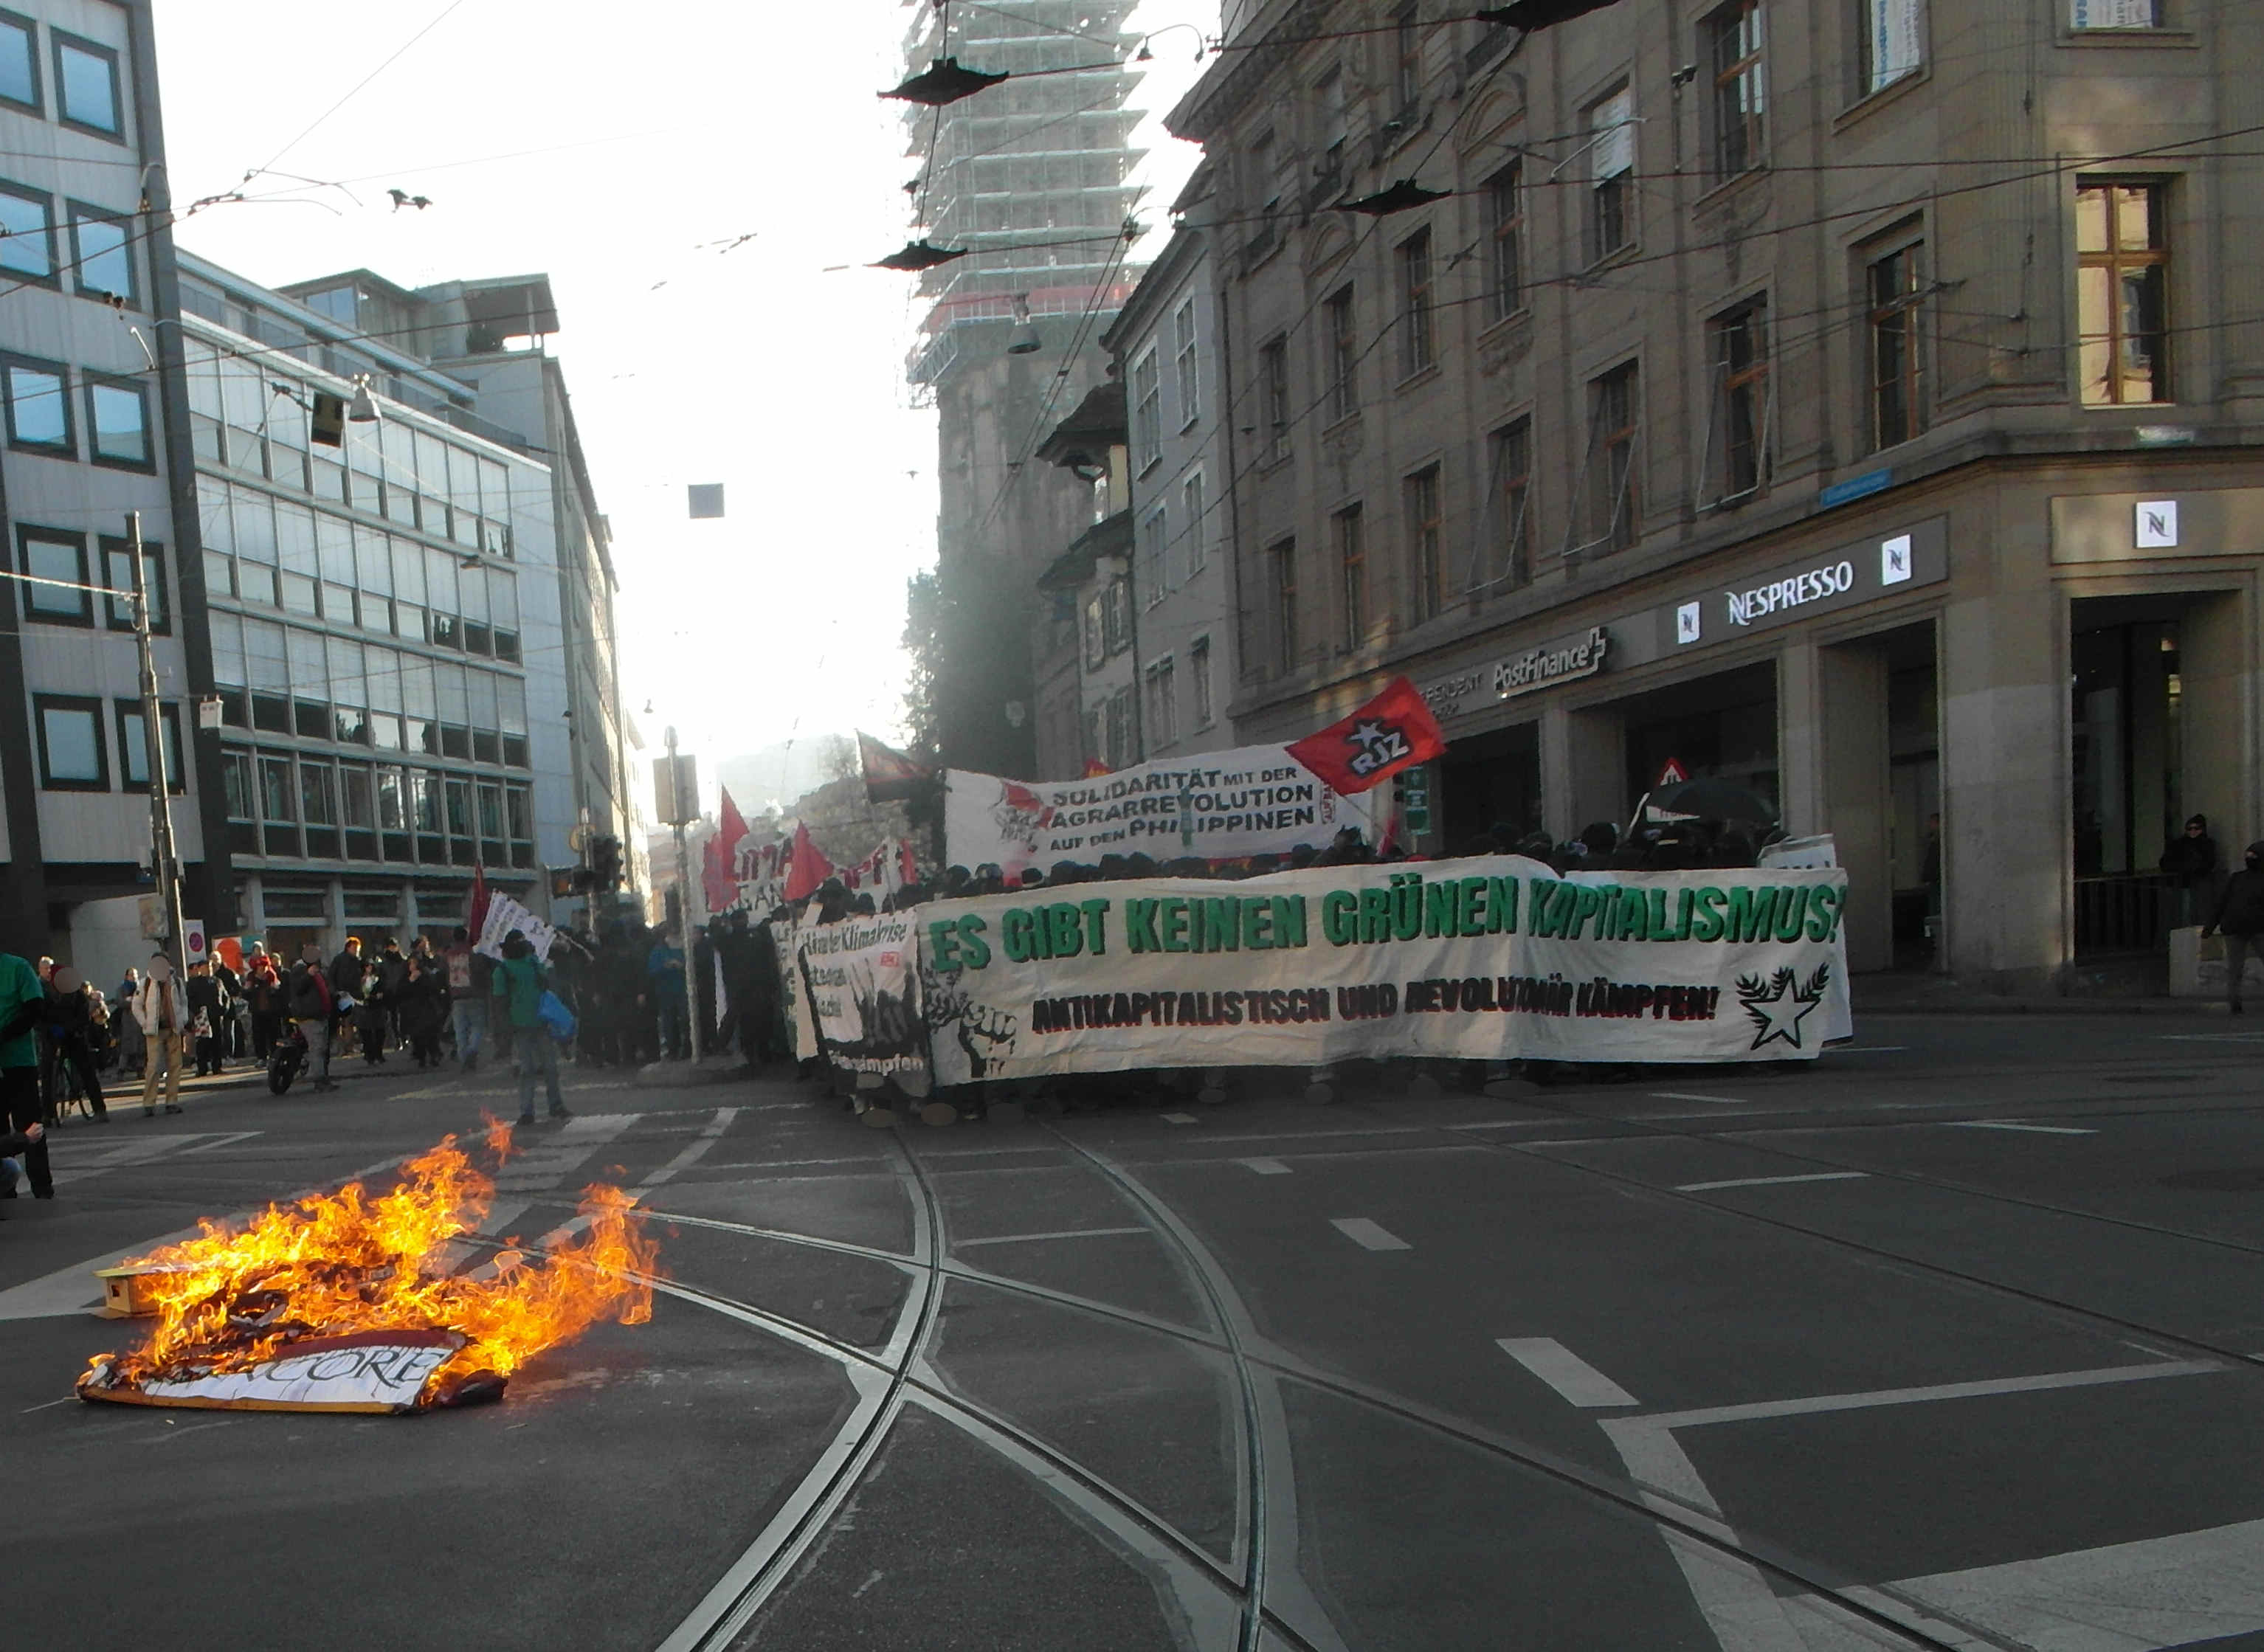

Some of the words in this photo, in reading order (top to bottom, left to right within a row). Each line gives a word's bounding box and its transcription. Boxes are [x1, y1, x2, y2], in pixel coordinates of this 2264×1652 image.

[2143, 511, 2171, 537] N
[1887, 549, 1905, 572] N
[1724, 561, 1854, 626] NESPRESSO
[1493, 643, 1590, 691] PostFinance
[1351, 731, 1410, 775] RJZ
[1051, 784, 1314, 829] AGRARREVOLUTION
[1052, 768, 1222, 807] SOLIDARITÄT
[1224, 772, 1254, 787] MIT
[1261, 767, 1297, 783] DER
[1050, 836, 1084, 851] AUF
[1089, 829, 1125, 847] DEN
[1129, 806, 1314, 837] PHIIPPINEN
[841, 919, 908, 951] Klimakrise
[928, 913, 992, 974] ES
[1001, 898, 1111, 963] GIBT
[1125, 894, 1308, 955] KEINEN
[1322, 872, 1519, 947] GRÜNEN
[1528, 877, 1845, 944] KAPITALISMUS!
[1032, 986, 1331, 1034] ANTIKAPITALISTISCH
[1336, 983, 1398, 1022] UND
[1576, 976, 1722, 1021] KÄMPFEN!
